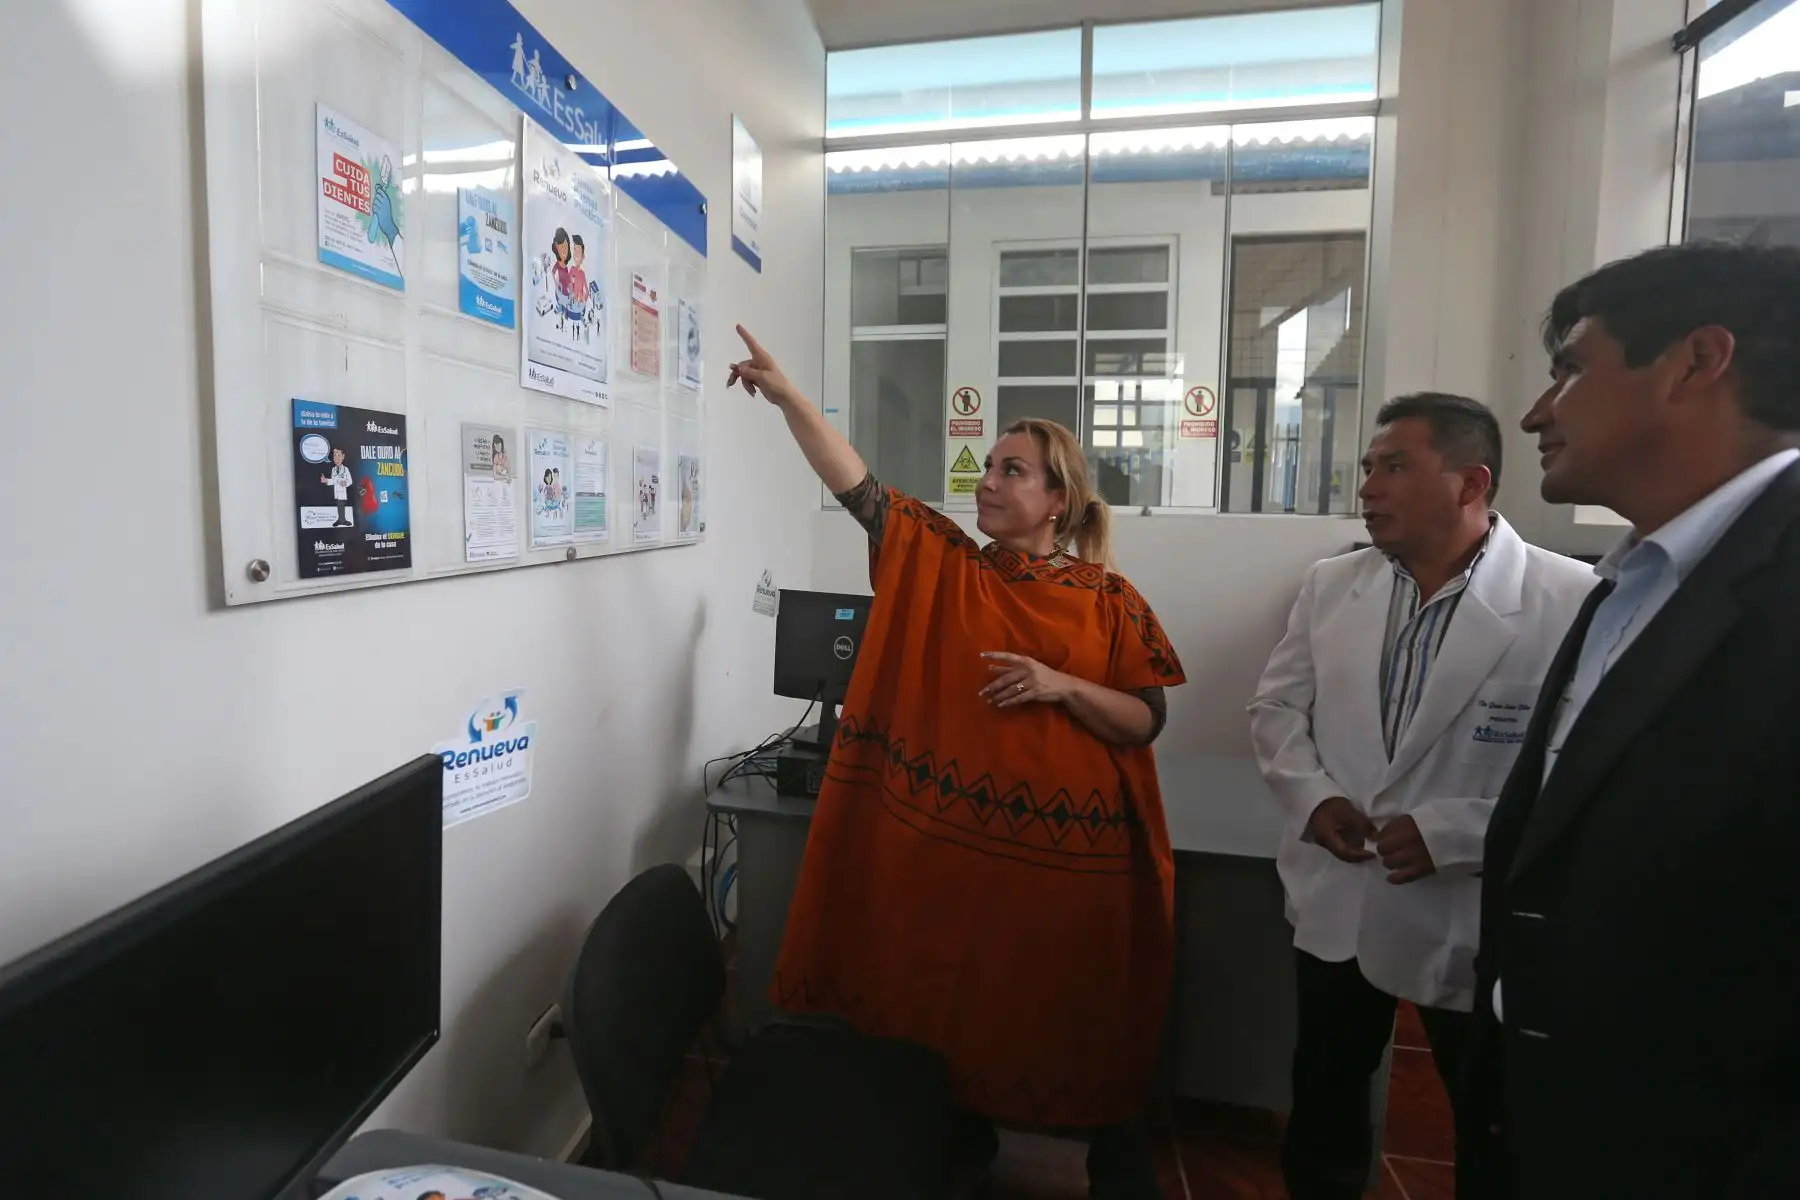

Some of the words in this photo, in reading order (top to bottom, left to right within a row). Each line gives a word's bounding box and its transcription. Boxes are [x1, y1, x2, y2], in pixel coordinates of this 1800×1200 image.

[553, 86, 617, 167] EsSalud
[335, 159, 370, 187] CUIDA
[323, 181, 370, 213] DIENTES
[349, 178, 370, 198] TUS
[378, 425, 399, 436] EsSalud
[360, 445, 376, 460] DALE
[377, 445, 393, 460] DURO
[377, 461, 404, 477] ZANCUDO
[325, 542, 345, 551] EsSalud
[836, 643, 851, 653] DELL
[440, 735, 529, 771] Renueva
[454, 757, 512, 784] EsSalud
